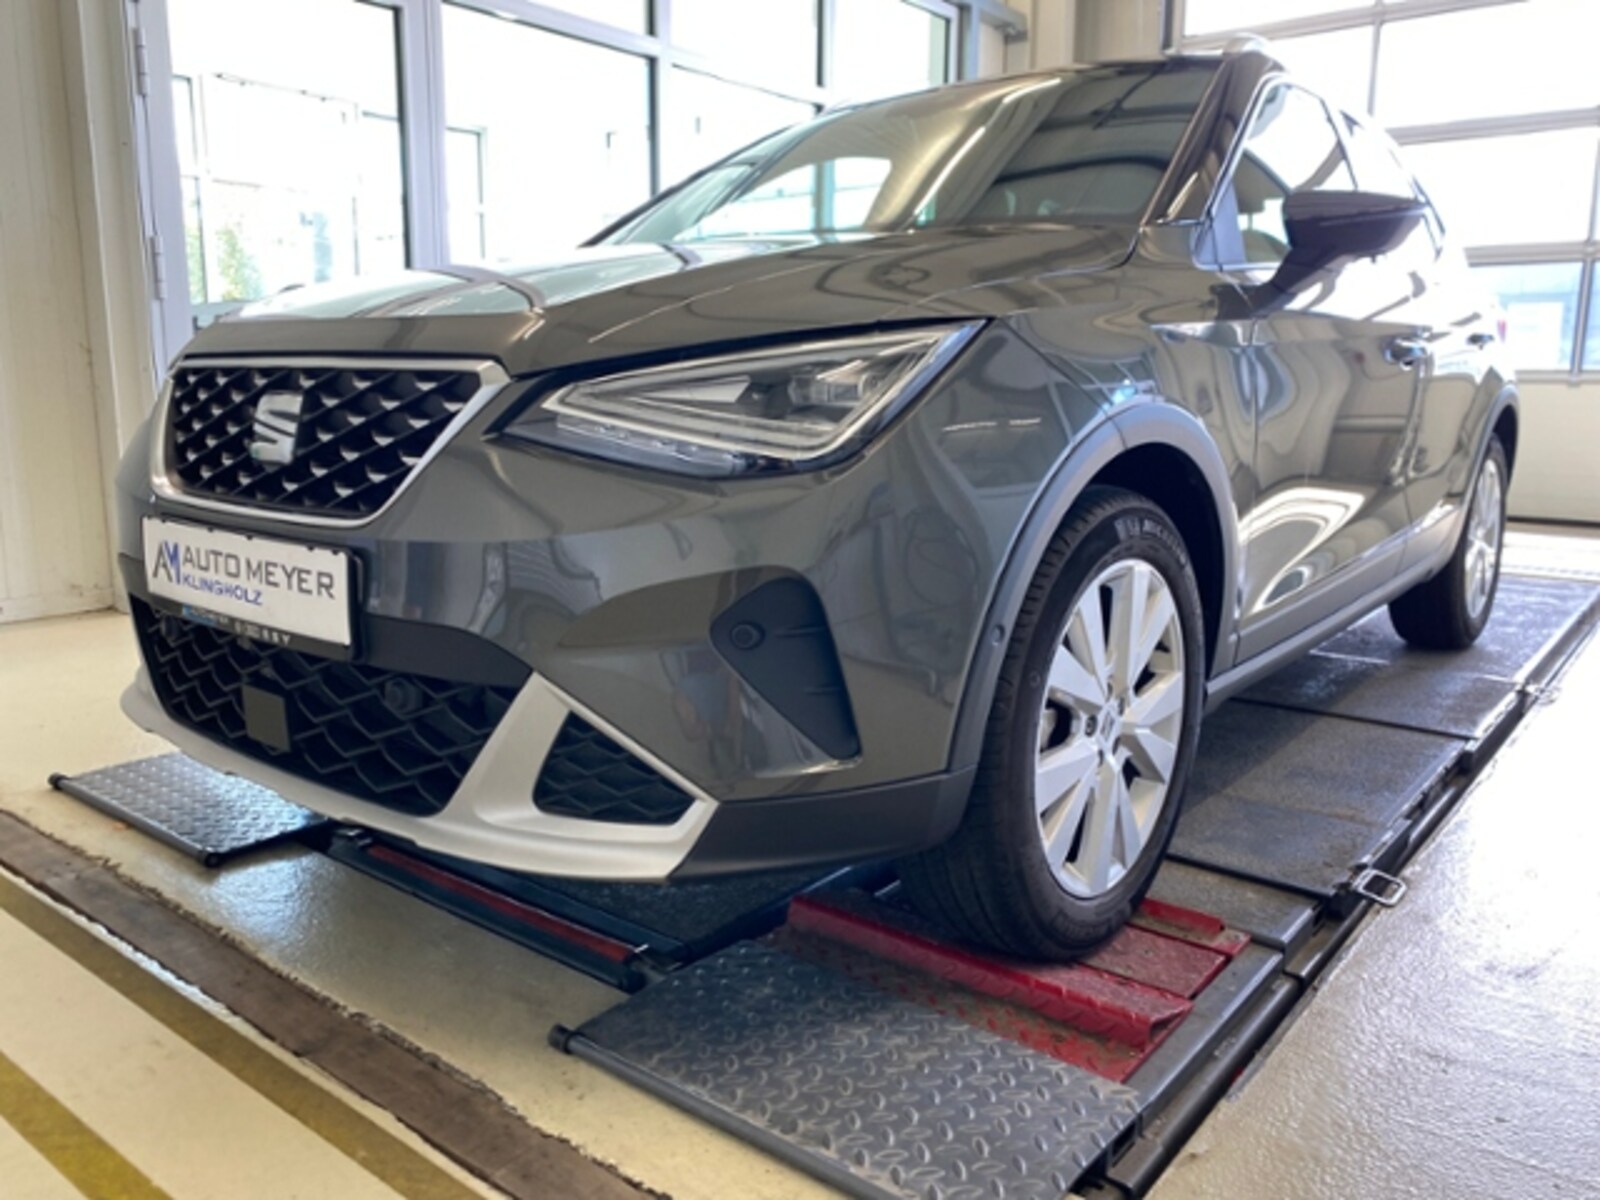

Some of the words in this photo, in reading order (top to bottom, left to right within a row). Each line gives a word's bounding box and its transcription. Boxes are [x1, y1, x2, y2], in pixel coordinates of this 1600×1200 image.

[182, 545, 241, 579] AUTO
[246, 556, 335, 600] MEYER
[182, 573, 263, 606] KLINGHOLZ
